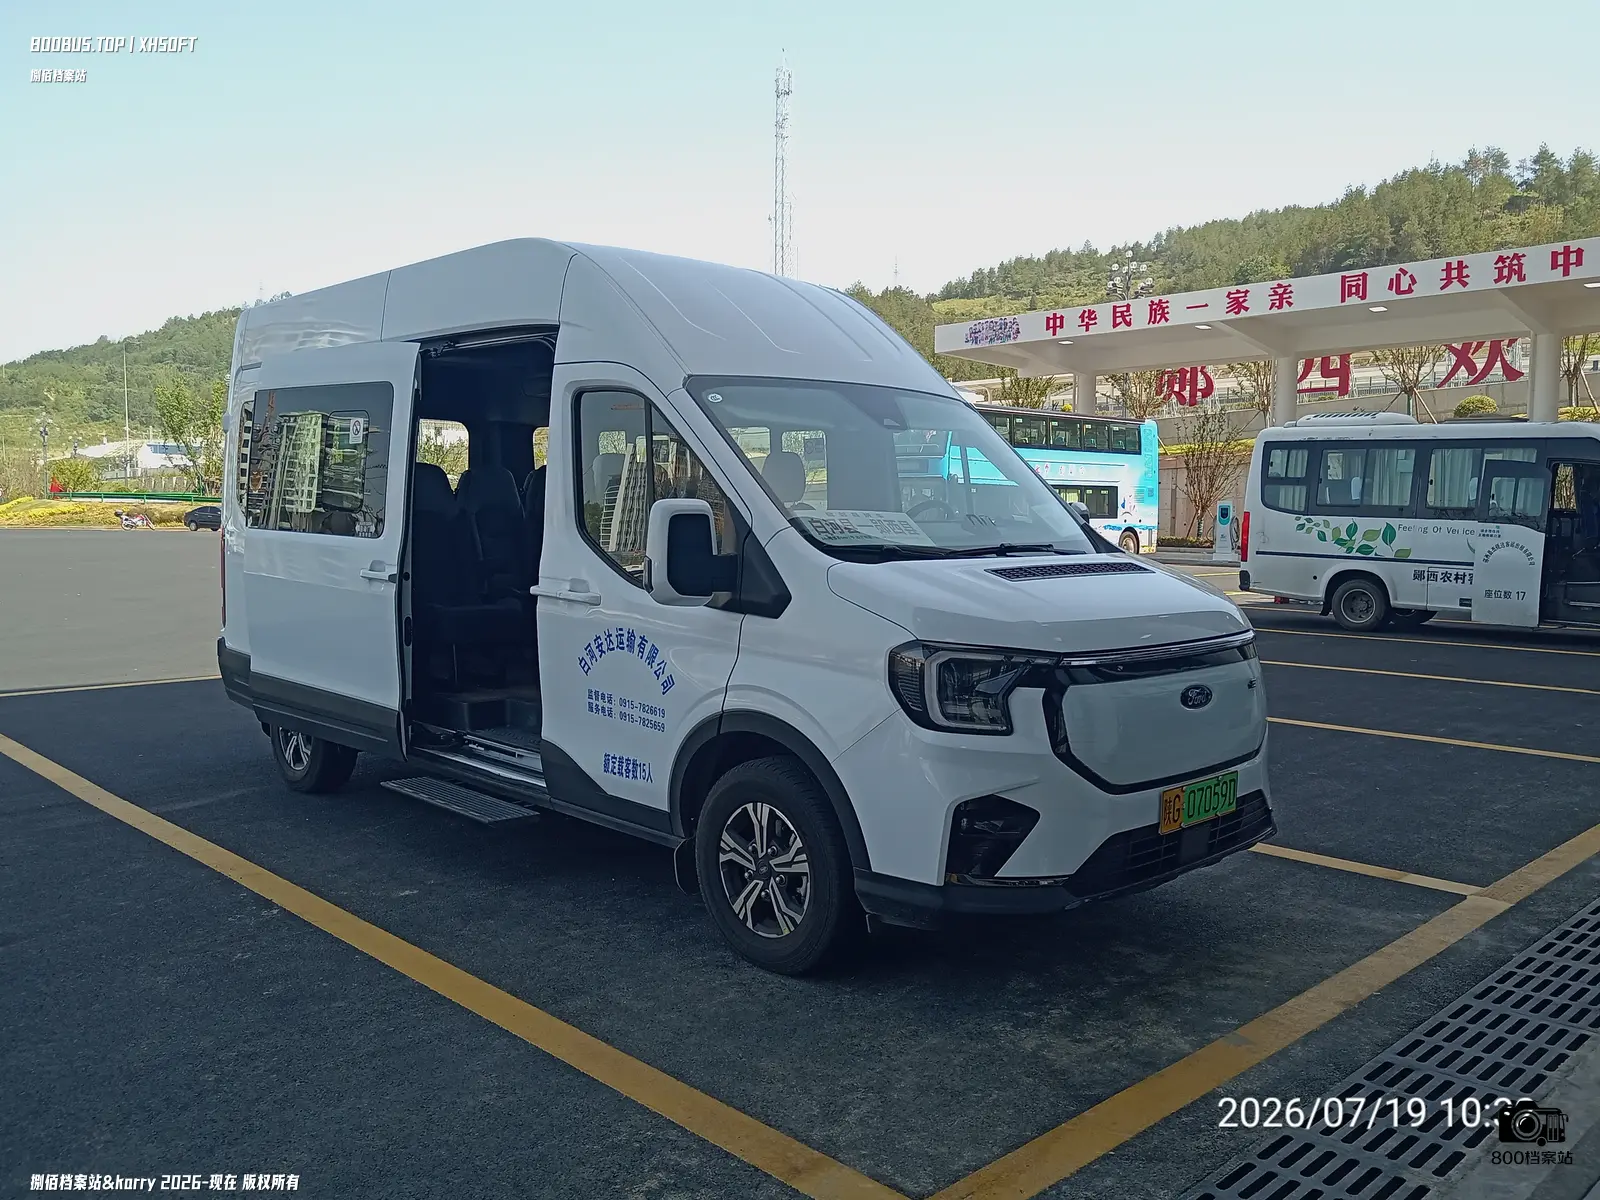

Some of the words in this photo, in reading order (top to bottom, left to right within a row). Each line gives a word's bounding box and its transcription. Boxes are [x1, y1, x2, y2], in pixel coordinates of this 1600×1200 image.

[1045, 282, 1295, 337] 中华民族一家亲
[1340, 245, 1585, 304] 同心共筑中
[1398, 523, 1428, 534] Feeng
[1484, 589, 1512, 600] 座位数
[1515, 591, 1526, 601] 17
[577, 628, 675, 695] 白河安达运输有限公司
[1187, 688, 1209, 706] Ford
[603, 752, 654, 784] 额定载客数15人
